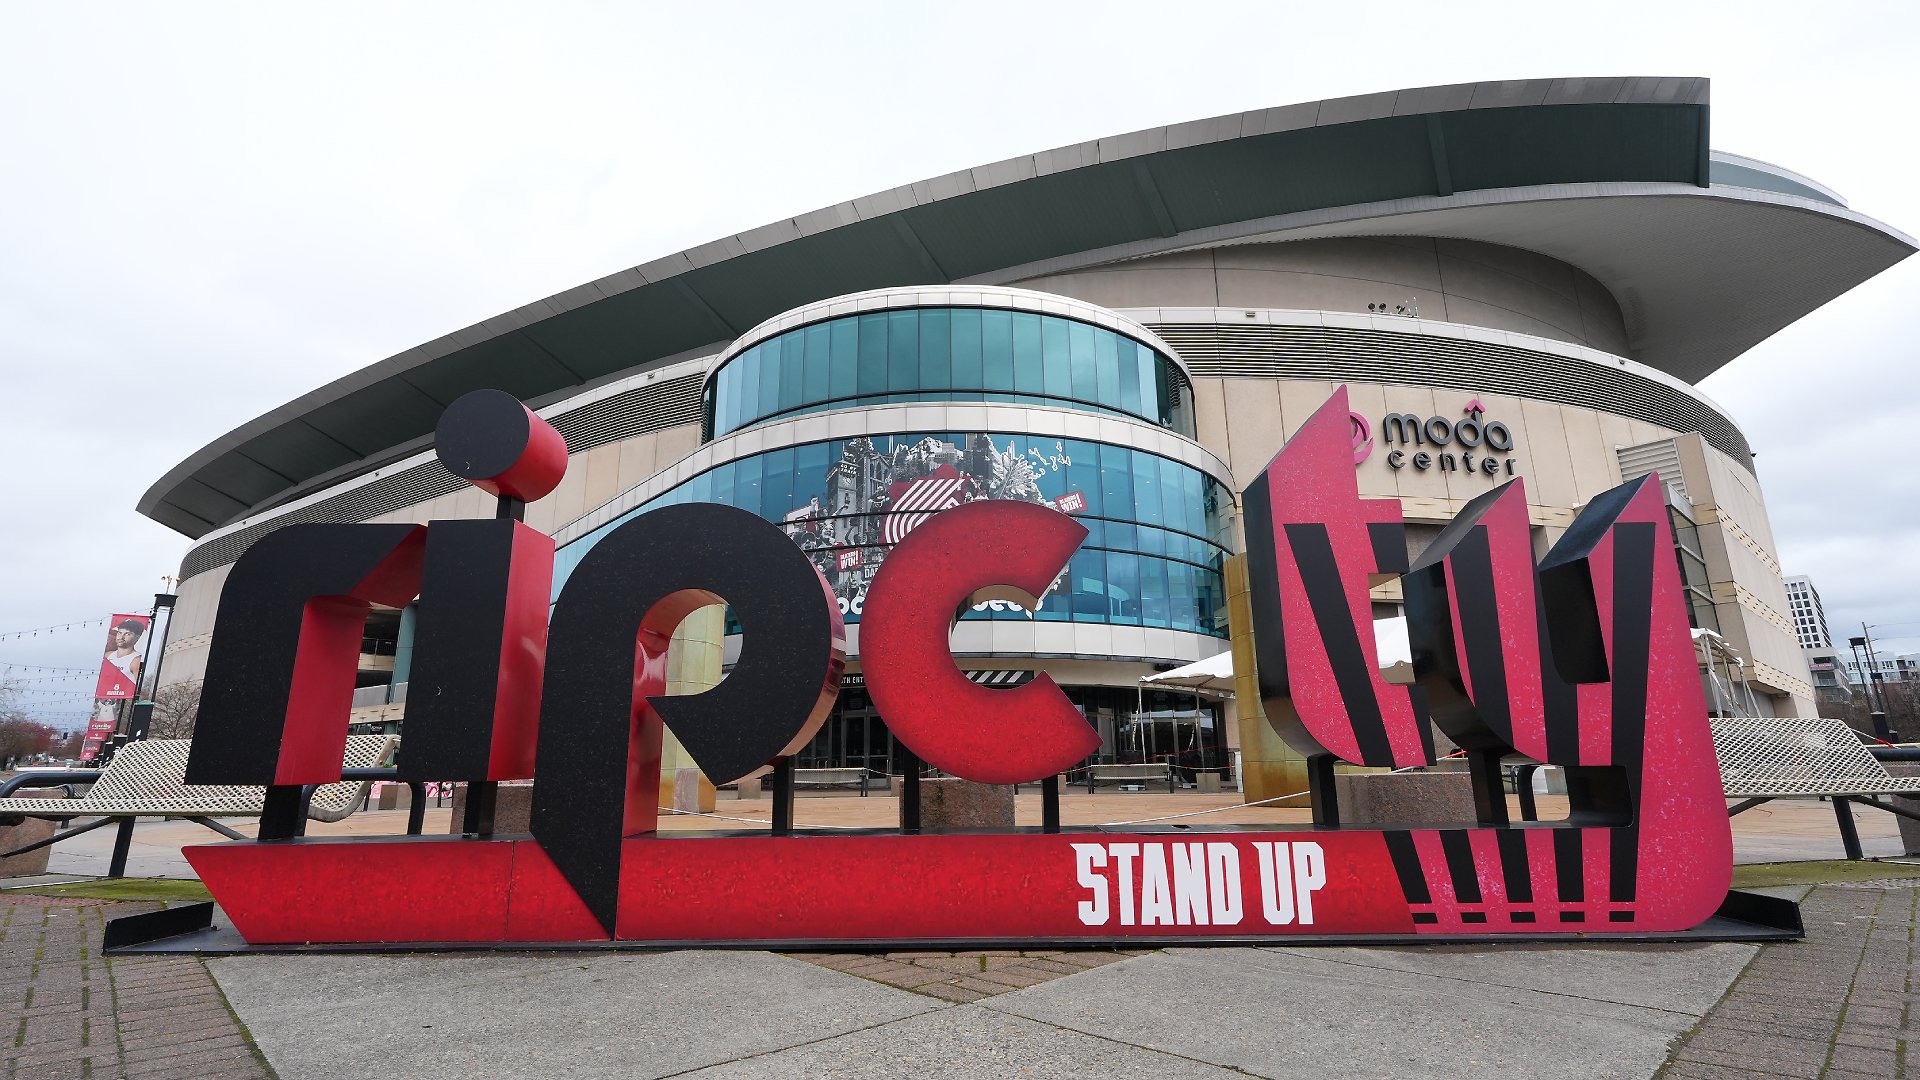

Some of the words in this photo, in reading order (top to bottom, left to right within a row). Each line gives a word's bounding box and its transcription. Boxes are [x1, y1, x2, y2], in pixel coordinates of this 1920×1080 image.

[1383, 399, 1515, 451] moda
[1387, 449, 1517, 476] center
[1070, 842, 1244, 926] STAND
[1251, 841, 1327, 925] UP
